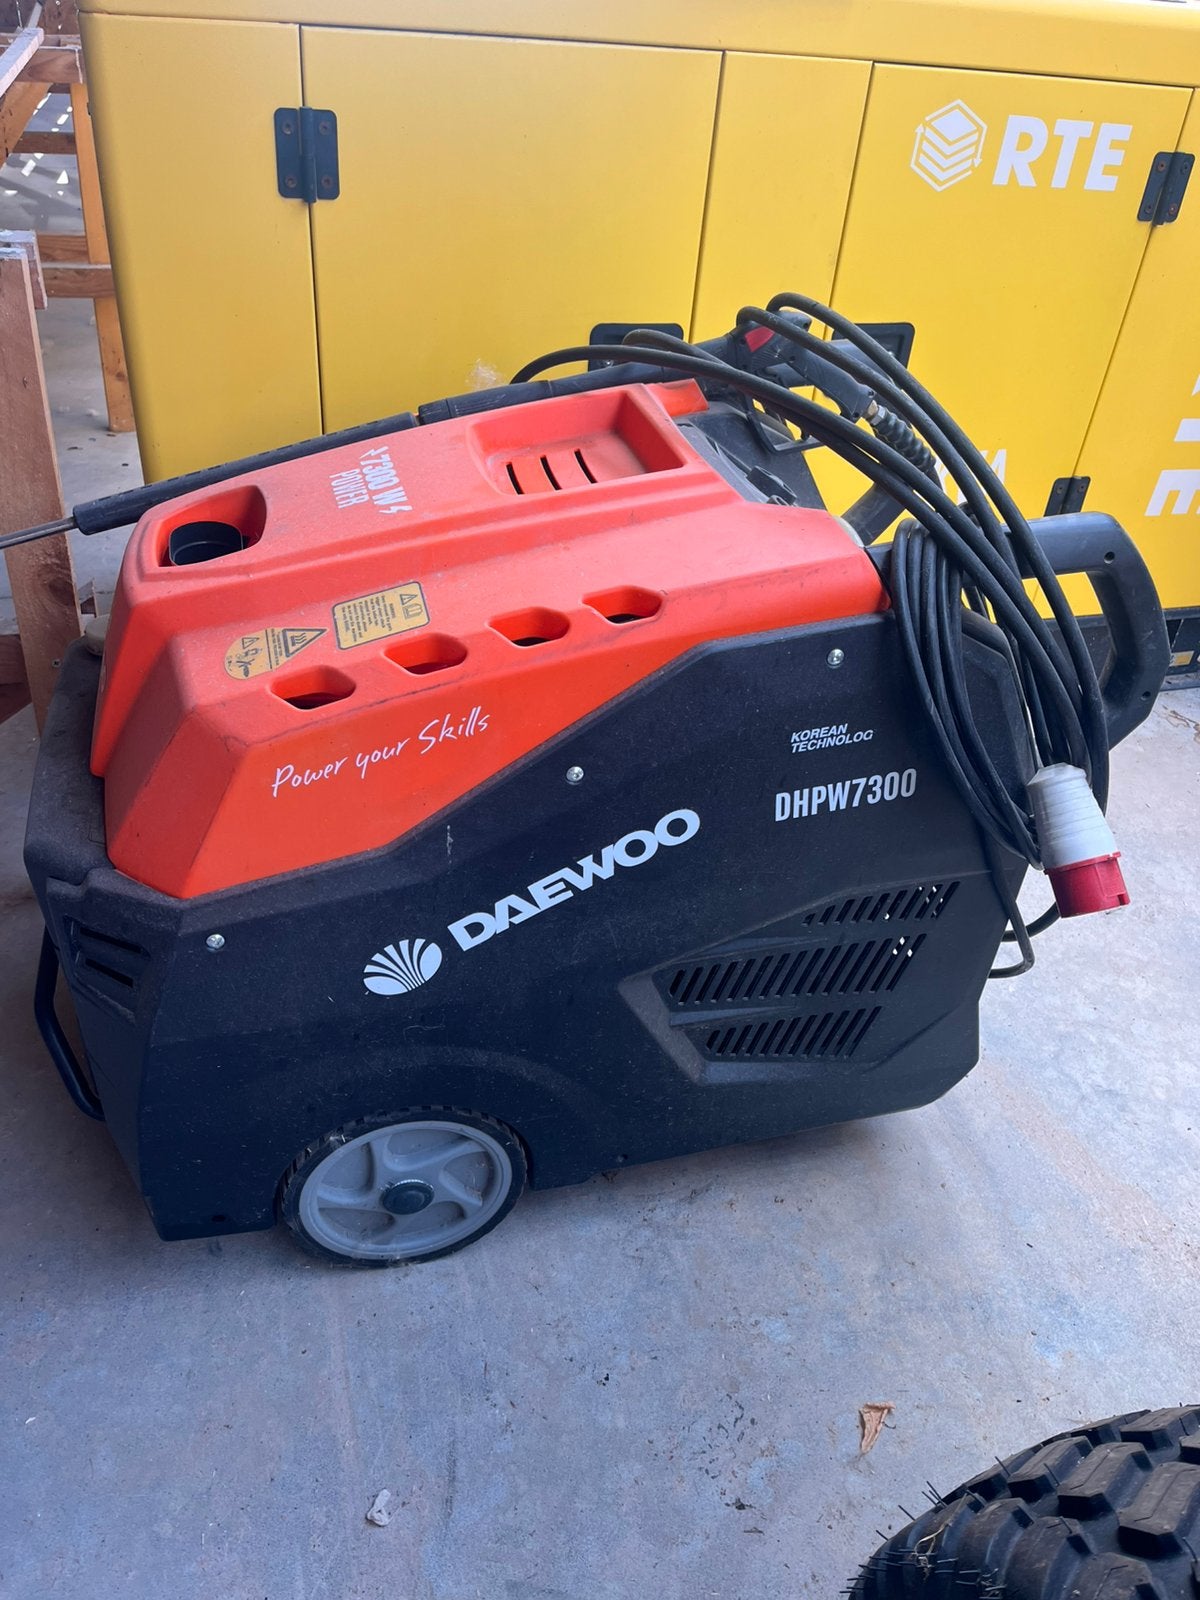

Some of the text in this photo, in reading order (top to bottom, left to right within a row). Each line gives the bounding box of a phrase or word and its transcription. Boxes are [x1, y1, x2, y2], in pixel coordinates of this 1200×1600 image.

[992, 114, 1133, 192] RTE
[329, 468, 369, 509] POWER
[360, 453, 408, 506] 7300 W
[271, 705, 491, 798] Power your Skills
[791, 723, 848, 743] KOREAN
[791, 729, 874, 754] TECHNOLOG
[775, 768, 917, 822] DHPW7300
[447, 808, 701, 952] DAEWOO
